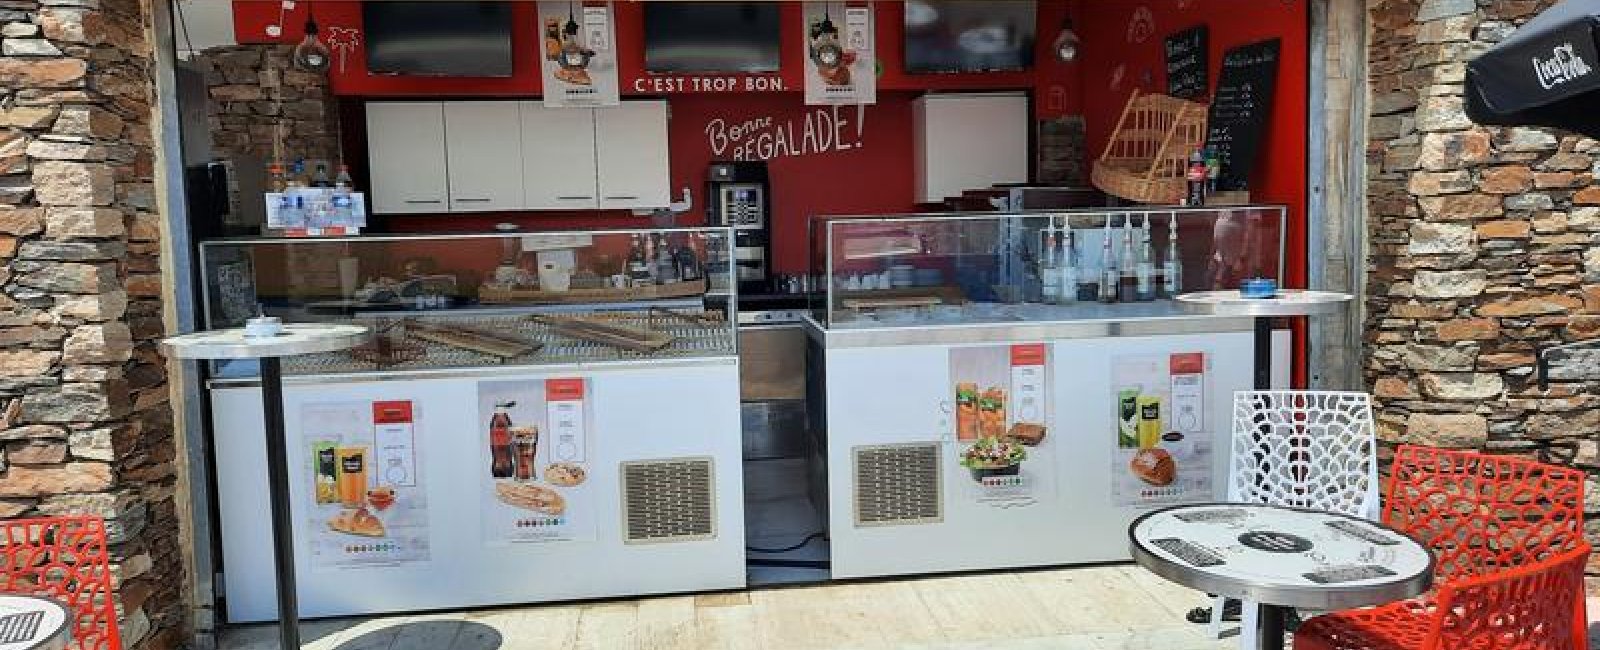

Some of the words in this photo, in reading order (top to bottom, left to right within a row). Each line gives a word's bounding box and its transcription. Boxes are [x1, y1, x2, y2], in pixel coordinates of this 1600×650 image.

[634, 76, 684, 92] C'EST
[691, 76, 738, 92] TROP
[744, 76, 789, 92] BON.
[704, 116, 773, 156] Bonne
